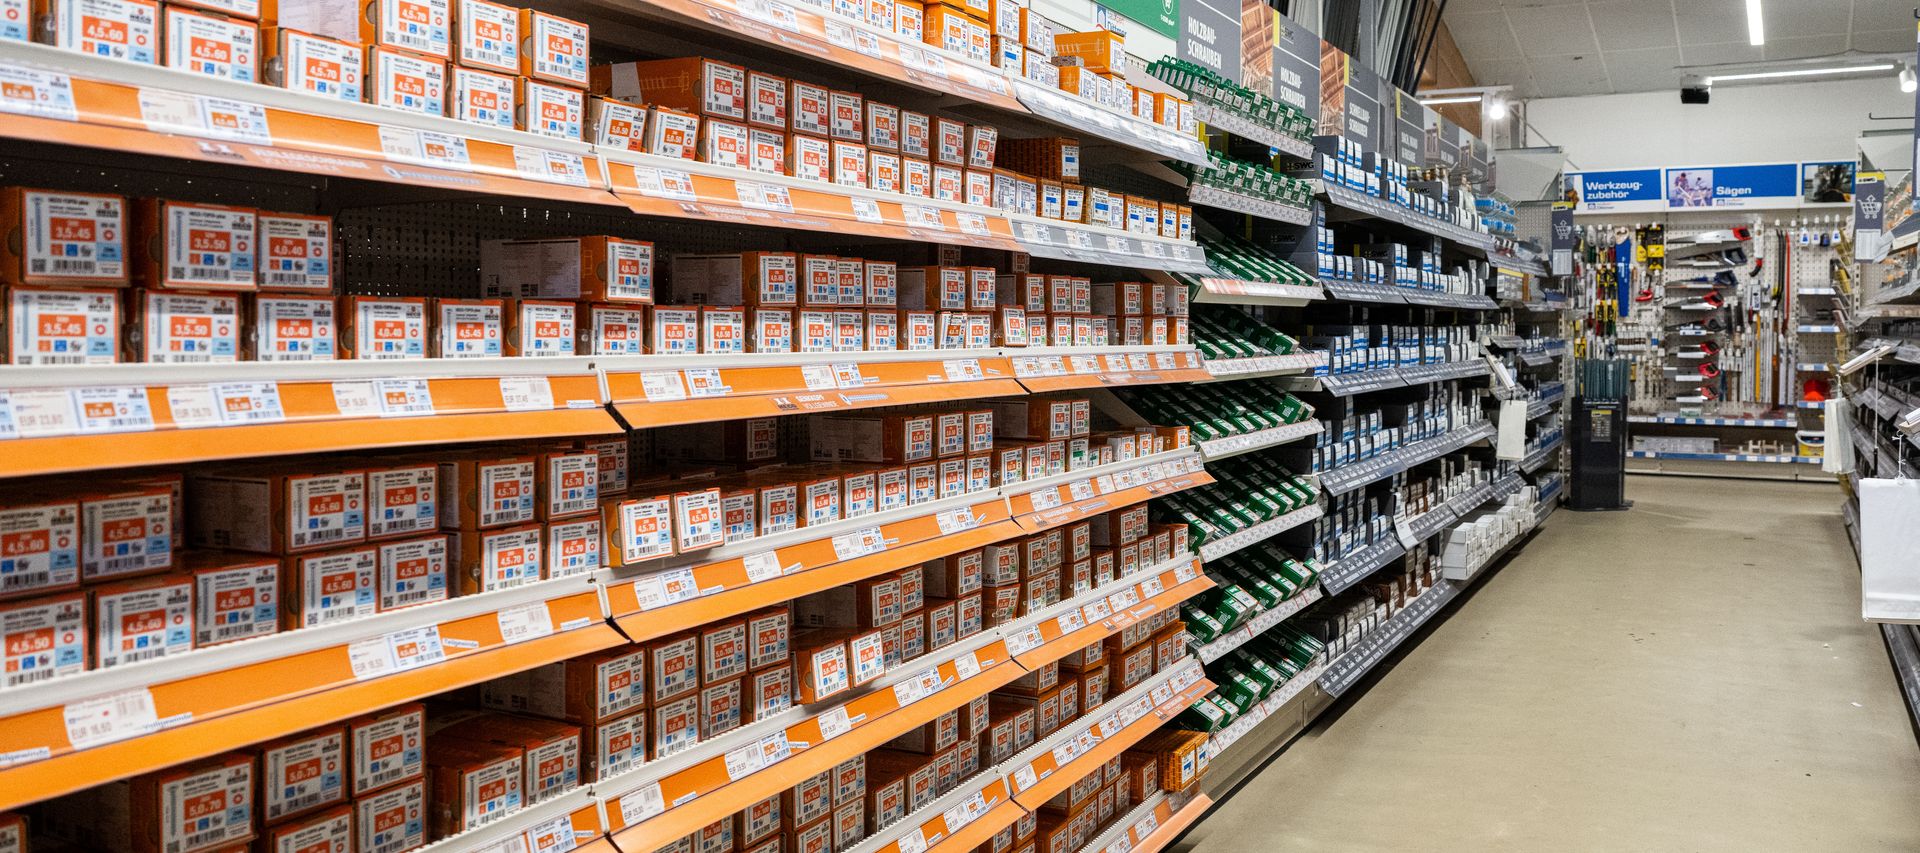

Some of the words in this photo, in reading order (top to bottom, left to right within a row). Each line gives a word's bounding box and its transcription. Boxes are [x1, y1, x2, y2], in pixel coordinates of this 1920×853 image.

[1188, 16, 1216, 44] HOLZBAU-
[1188, 39, 1221, 69] SCHRAUBEN
[1586, 182, 1642, 192] Werkzeug-
[1717, 186, 1751, 196] Sägen
[1587, 191, 1629, 199] zubehör
